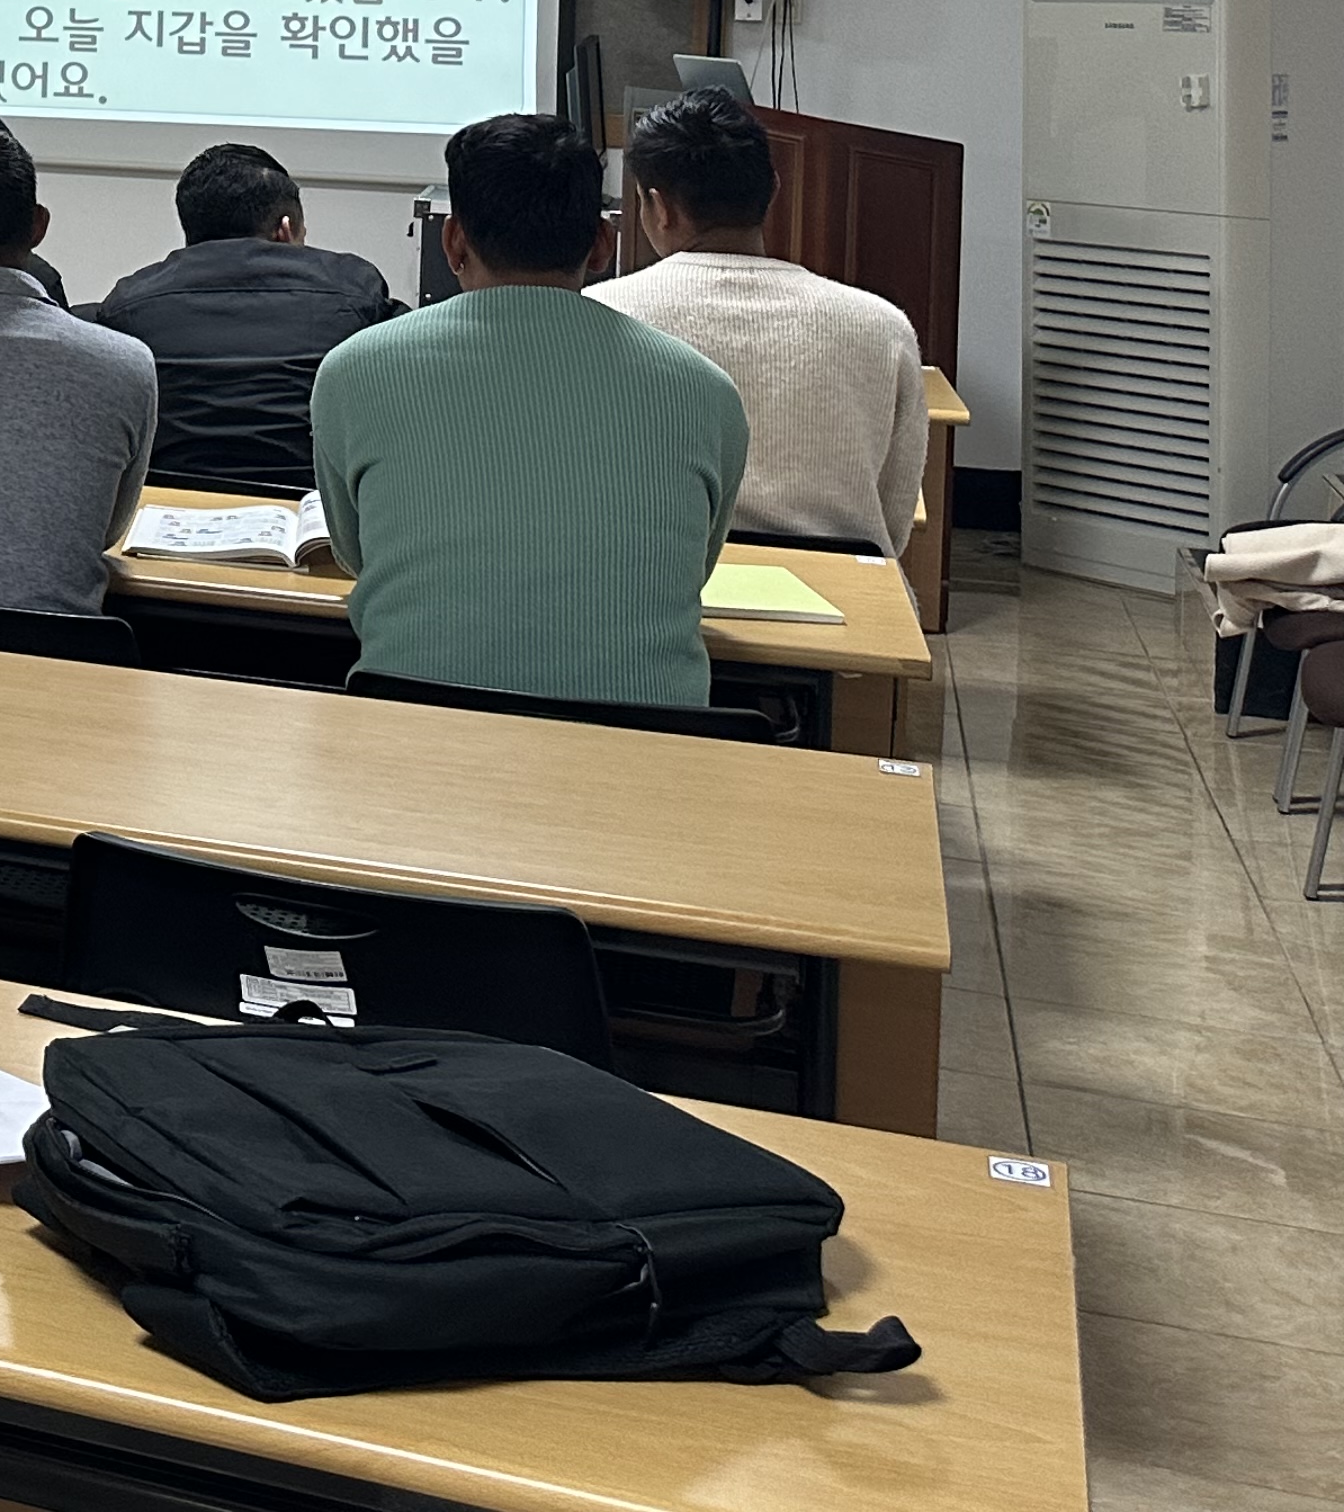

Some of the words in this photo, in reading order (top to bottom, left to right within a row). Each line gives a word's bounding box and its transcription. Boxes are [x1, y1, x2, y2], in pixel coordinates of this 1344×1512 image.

[18, 5, 105, 53] 오늘
[124, 9, 258, 59] 지갑을
[279, 11, 470, 67] 확인했을
